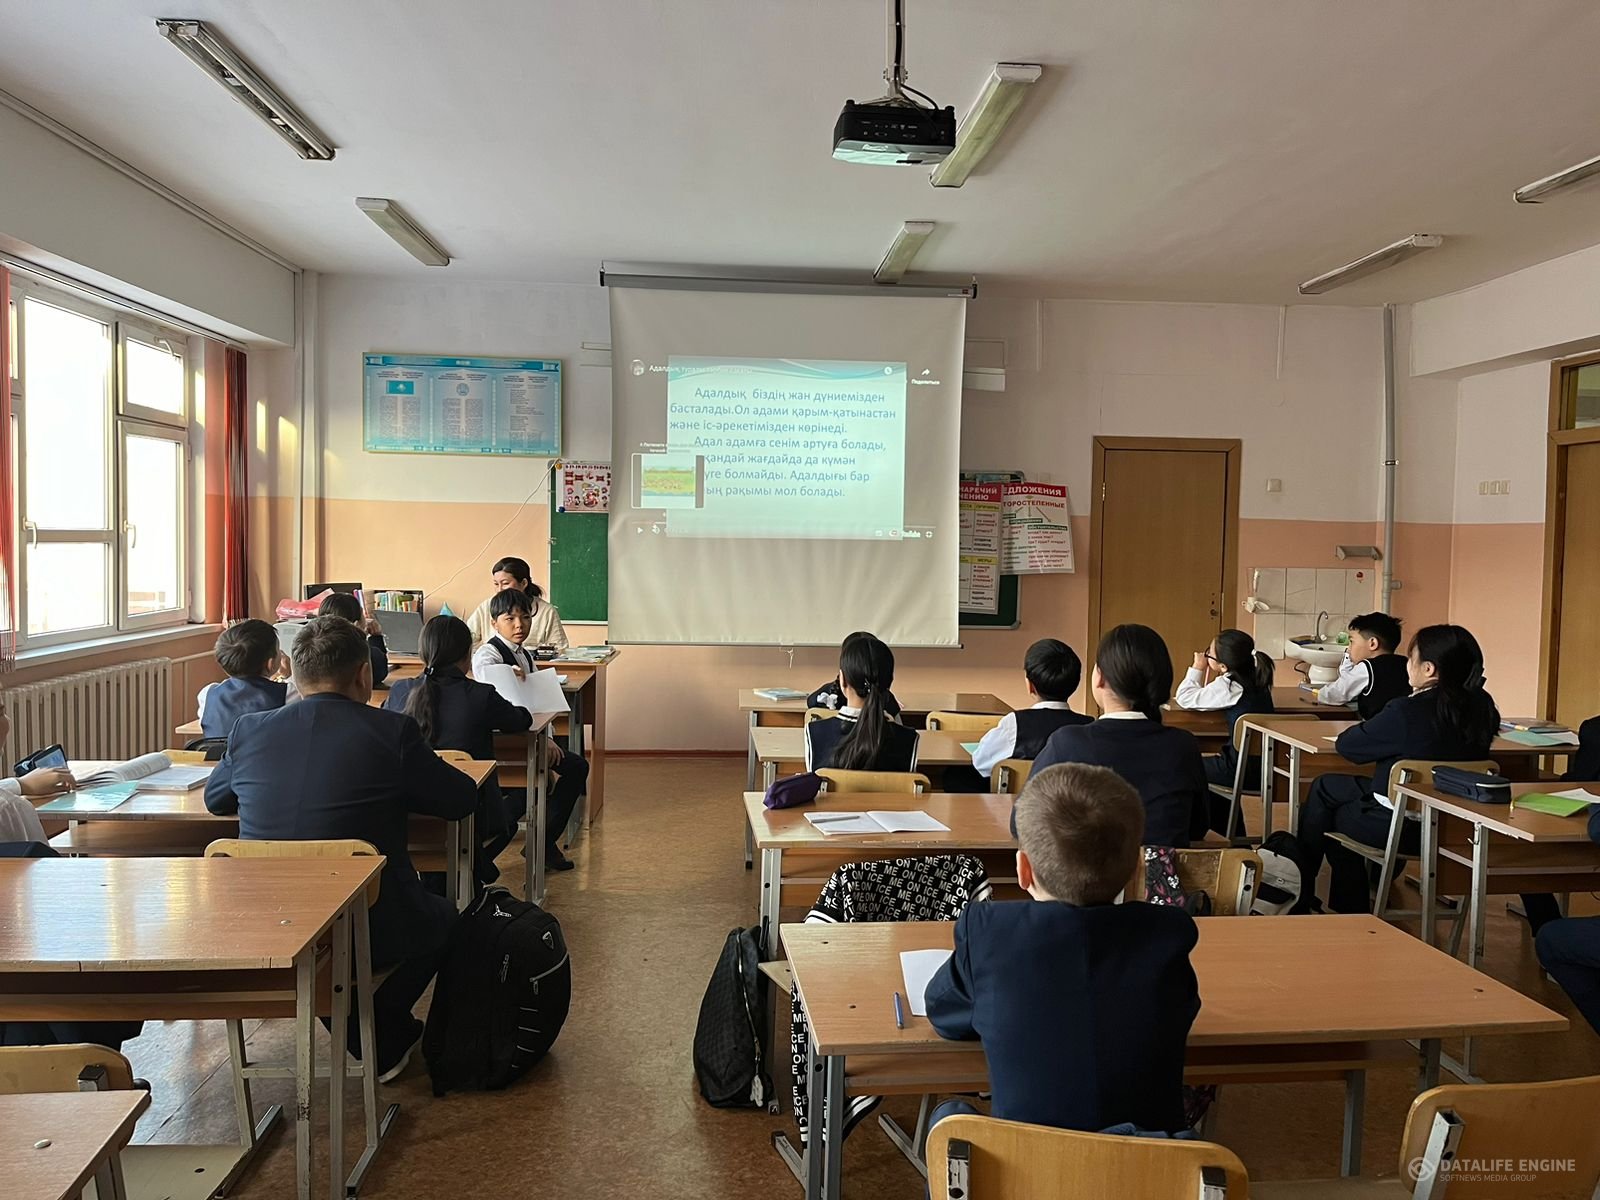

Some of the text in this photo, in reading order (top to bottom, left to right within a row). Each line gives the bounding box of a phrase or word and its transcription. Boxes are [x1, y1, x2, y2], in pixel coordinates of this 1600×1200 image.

[695, 387, 885, 402] Адалдық біздің жан дүниемізден
[753, 406, 789, 416] адами
[792, 407, 896, 418] қарым-қатынастан
[670, 420, 847, 435] және іс-әрекетімізден көрінеді.
[694, 436, 887, 452] Адал адамға сенім артуға болады,
[747, 453, 802, 465] жағдайда
[804, 457, 819, 465] да
[822, 457, 856, 467] күмән
[724, 468, 787, 480] болмайды.
[790, 470, 847, 481] Адалдығы
[850, 470, 870, 483] бар
[725, 487, 771, 497] рақымы
[774, 487, 797, 496] мол
[800, 486, 846, 498] болады.
[896, 858, 911, 869] ON
[914, 861, 931, 874] ICE
[934, 868, 949, 880] ME
[951, 874, 966, 887] ON
[925, 856, 939, 867] ME
[943, 861, 957, 872] ON
[958, 866, 975, 880] ICE
[851, 870, 864, 880] ON
[867, 872, 884, 884] ICE
[889, 876, 904, 888] ME
[906, 881, 921, 892] ON
[923, 886, 939, 898] ICE
[943, 892, 958, 906] ME
[861, 861, 878, 872] ICE
[883, 864, 899, 876] ME
[902, 869, 916, 880] ON
[918, 874, 934, 887] ICE
[939, 880, 953, 892] ME
[956, 887, 969, 900] ON
[861, 882, 873, 891] ON
[875, 884, 892, 896] ICE
[897, 889, 912, 901] ME
[915, 894, 929, 906] ON
[931, 900, 946, 912] ICE
[879, 895, 897, 907] ICE
[901, 901, 916, 914] ME
[919, 906, 933, 918] ON
[934, 912, 951, 922] ICE
[884, 906, 901, 919] ICE
